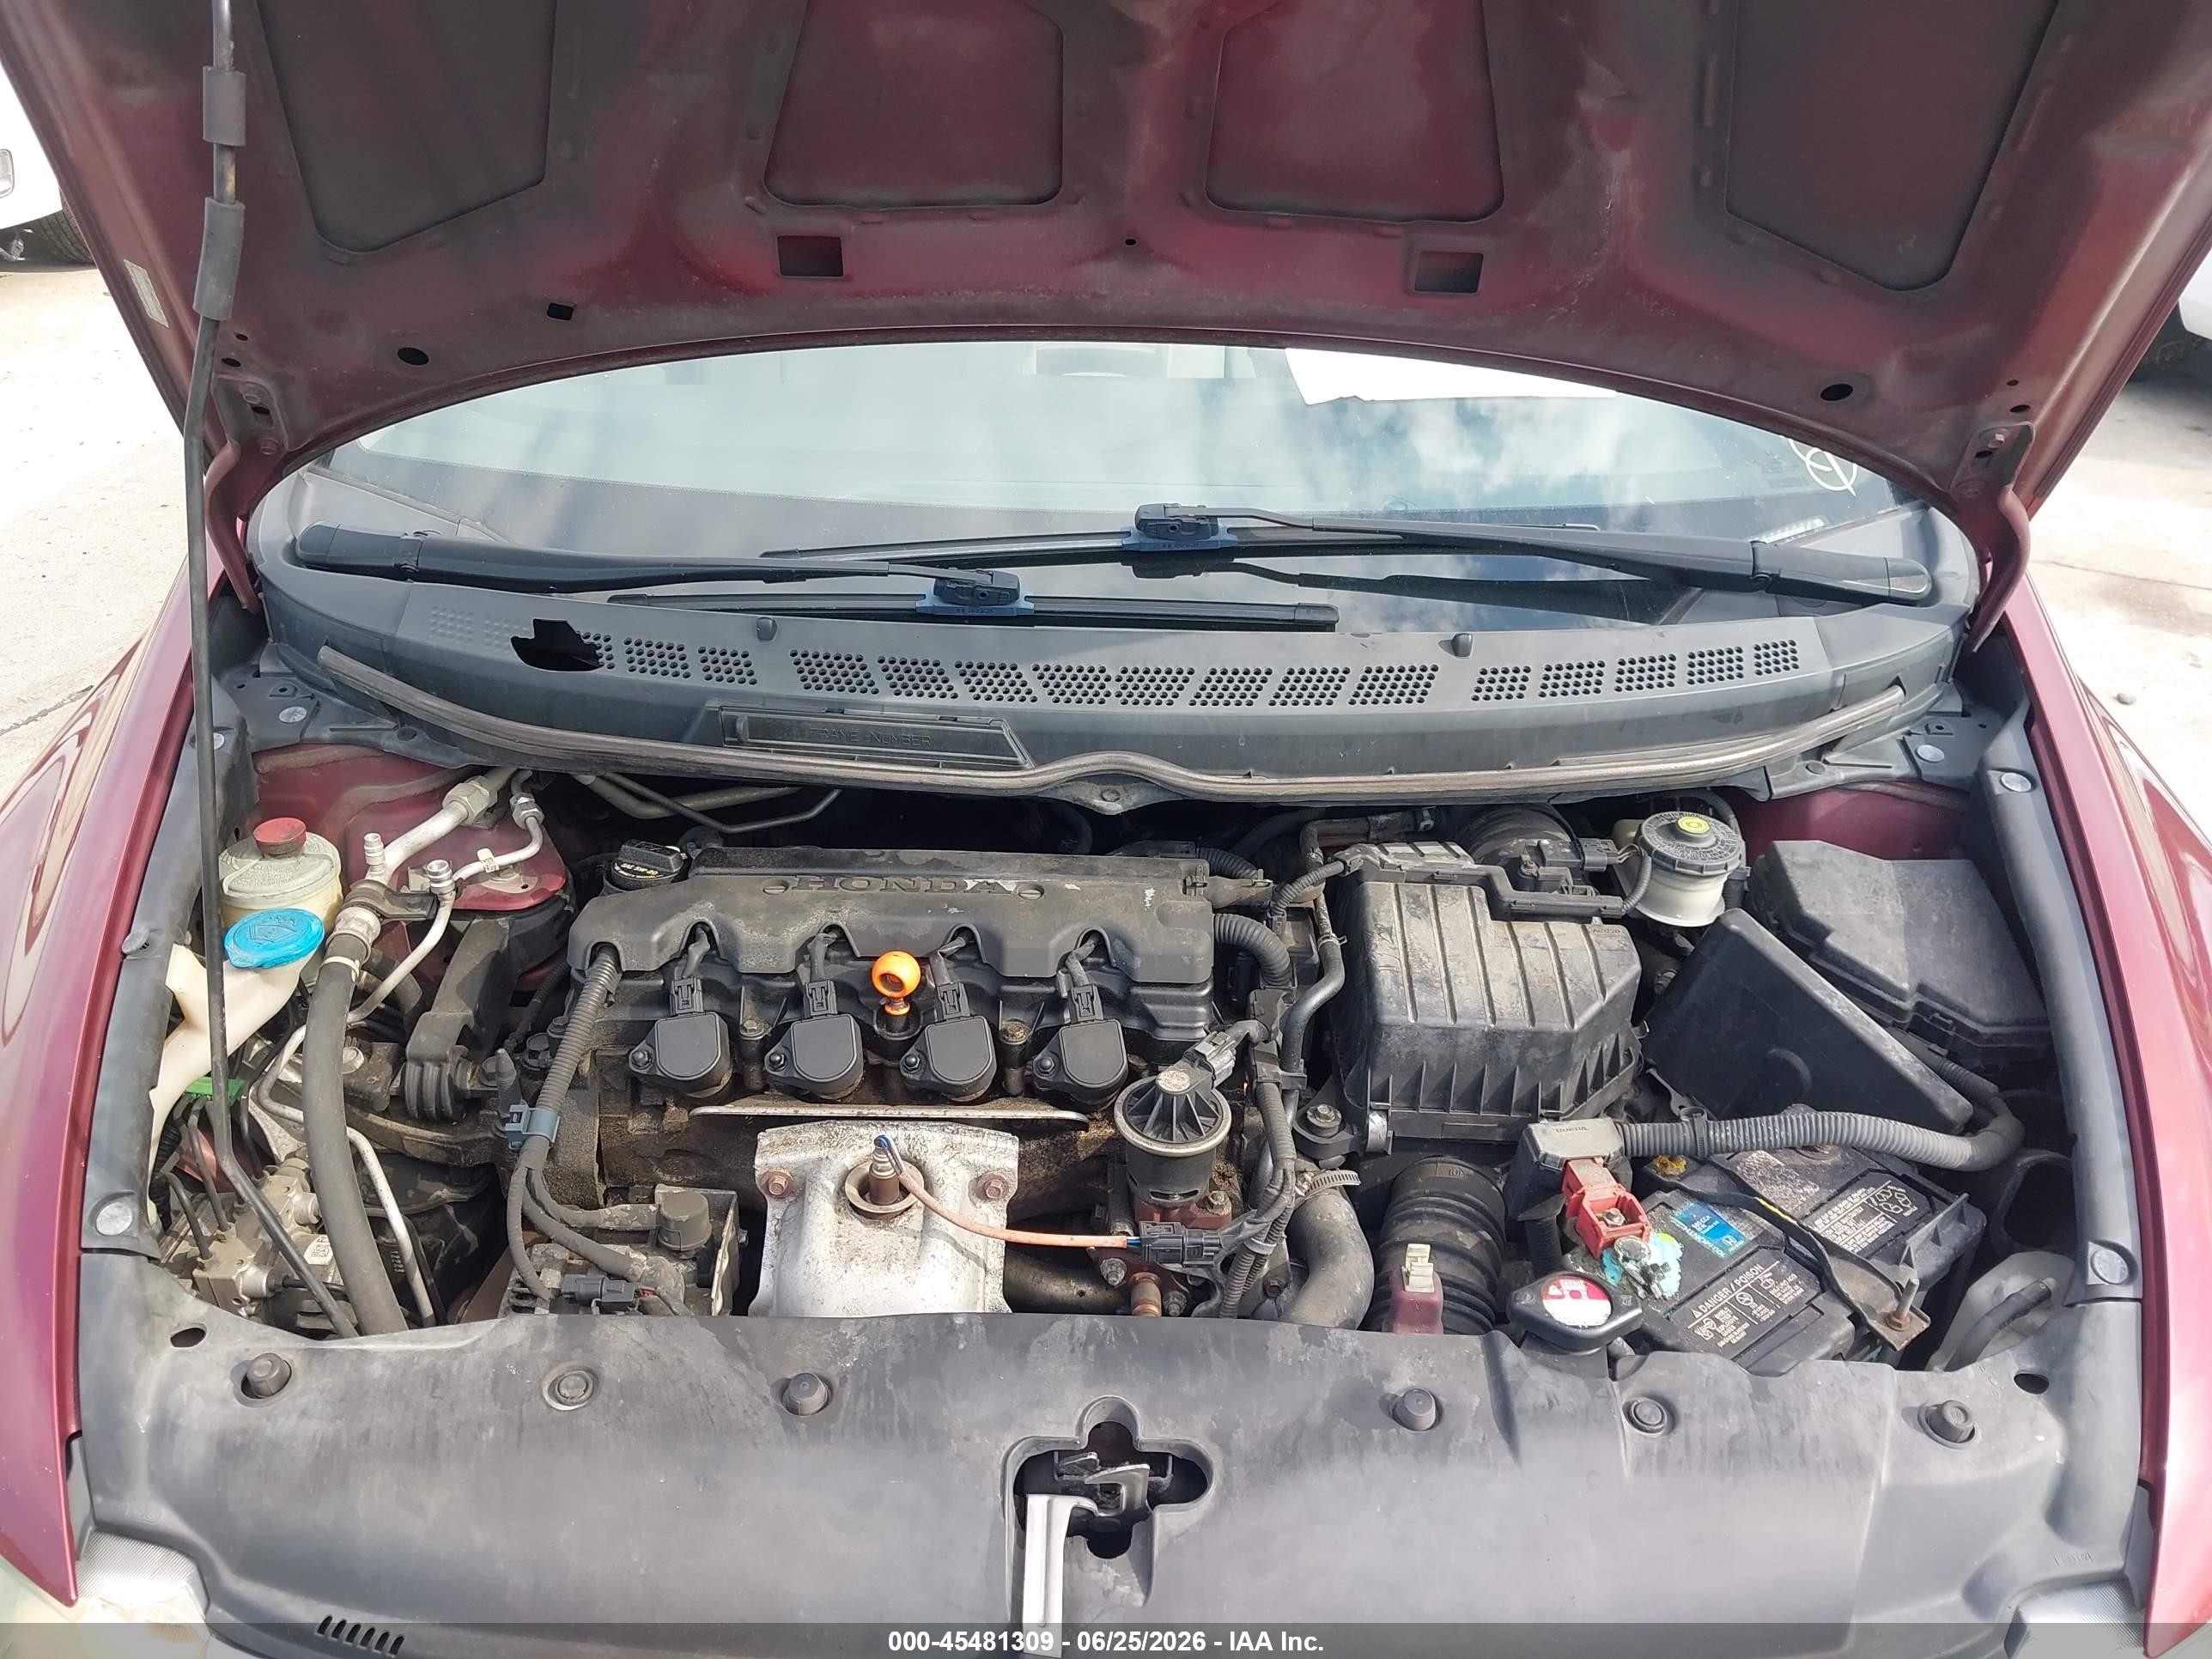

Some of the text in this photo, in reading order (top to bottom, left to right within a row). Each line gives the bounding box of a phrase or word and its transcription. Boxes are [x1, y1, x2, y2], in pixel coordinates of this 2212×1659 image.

[810, 727, 933, 748] FRAME NUMBER
[791, 874, 1012, 895] HONDA
[1698, 1287, 1733, 1313] DANGER
[1734, 1263, 1765, 1287] POISON
